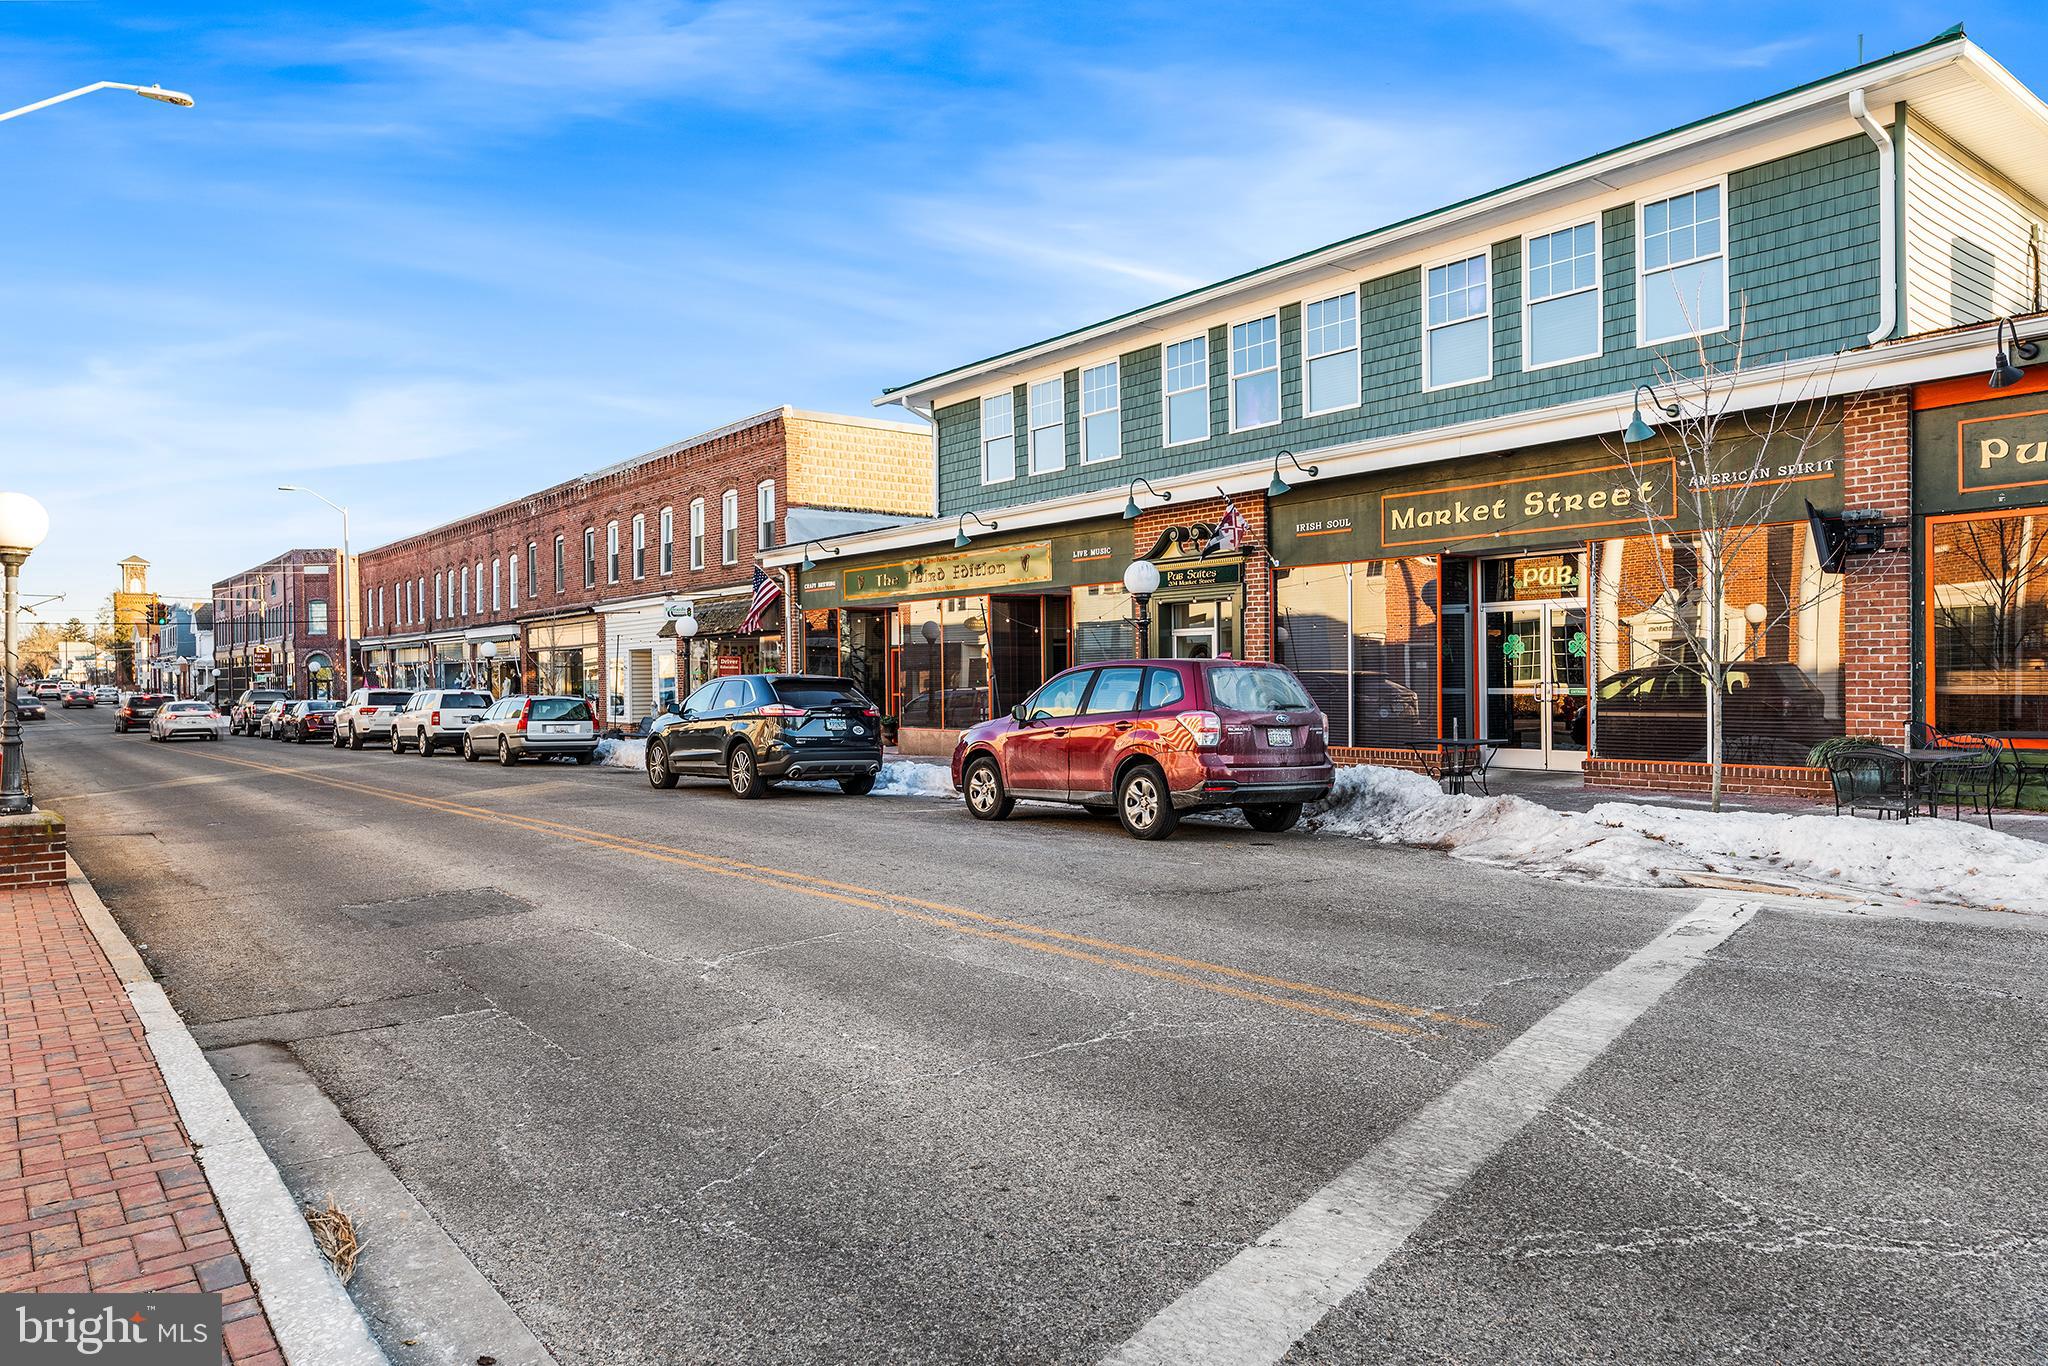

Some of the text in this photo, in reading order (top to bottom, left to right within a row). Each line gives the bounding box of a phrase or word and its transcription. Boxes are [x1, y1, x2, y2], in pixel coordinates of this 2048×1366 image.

[1688, 460, 1835, 486] AMERICAN SPIRIT
[1391, 481, 1653, 530] Market Street
[1296, 518, 1352, 532] IRISH SOUL
[1073, 547, 1111, 558] LIVE MUSIC
[876, 573, 900, 587] The
[907, 567, 945, 584] Third
[952, 561, 1006, 580] Edition
[1186, 569, 1217, 580] Suites
